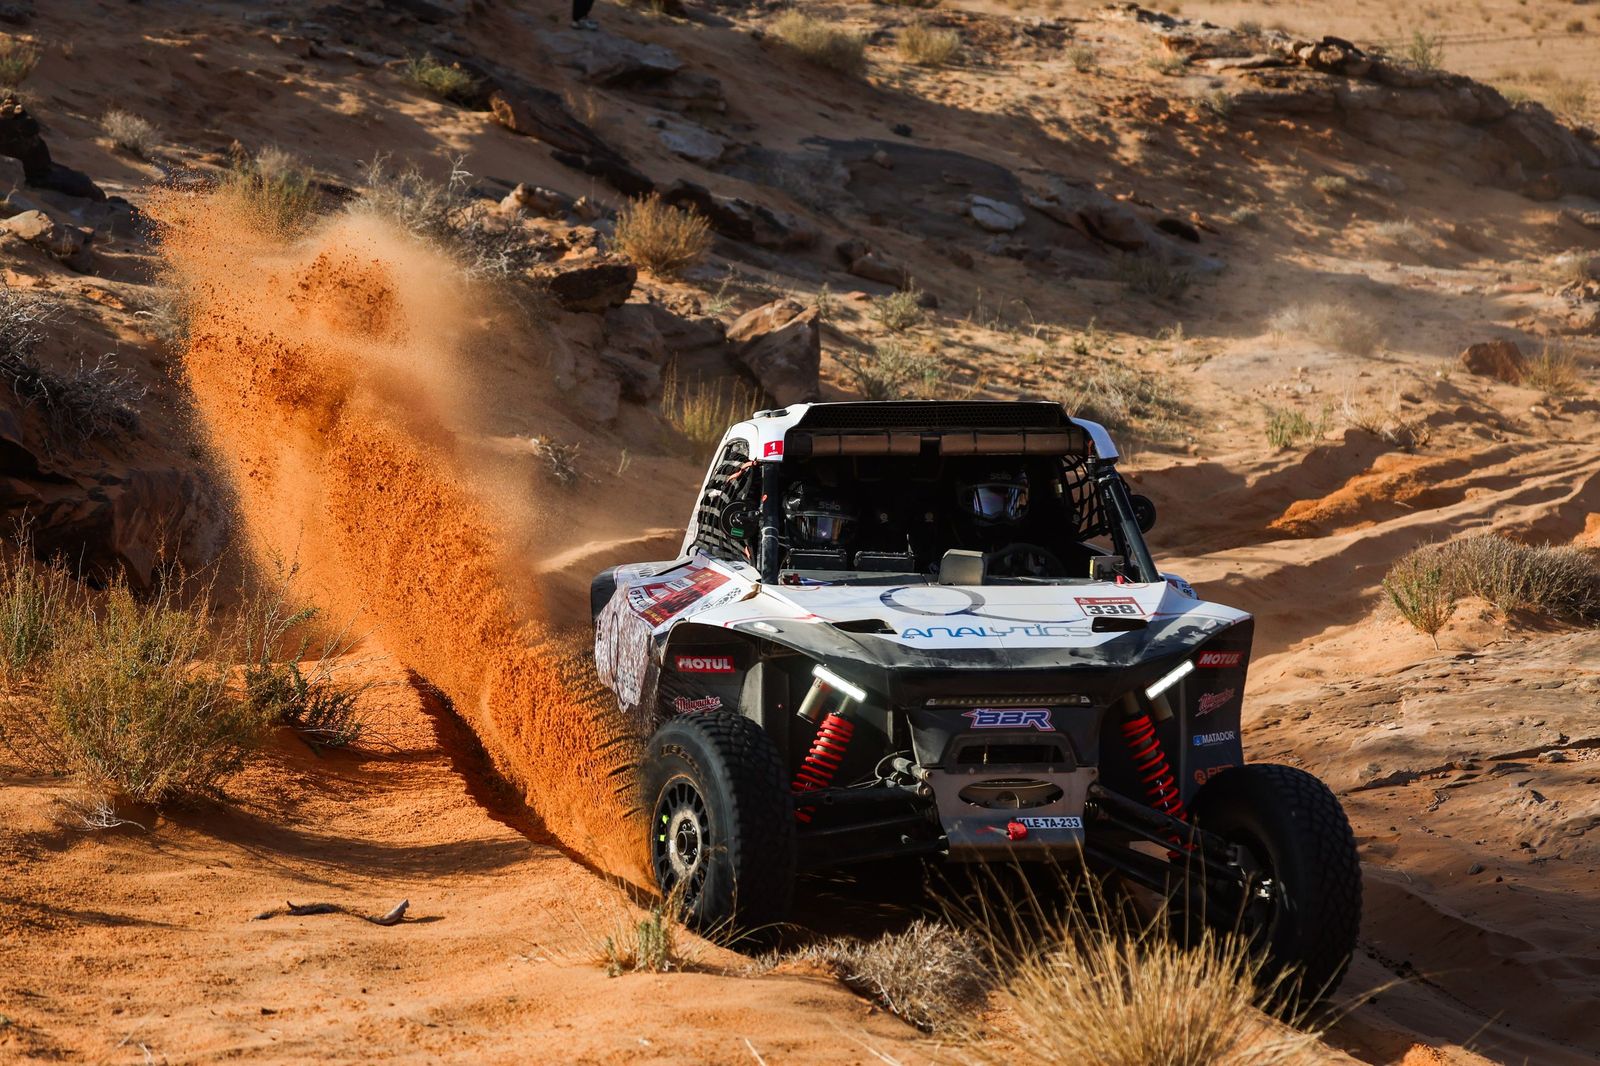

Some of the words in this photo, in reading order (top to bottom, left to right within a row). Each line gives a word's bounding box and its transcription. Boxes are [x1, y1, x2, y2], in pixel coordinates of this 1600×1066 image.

[1086, 604, 1137, 615] 338
[677, 657, 732, 670] MOTUL
[1199, 653, 1240, 665] MOTUL
[970, 708, 1056, 731] BBR
[1201, 730, 1236, 744] MATADOR
